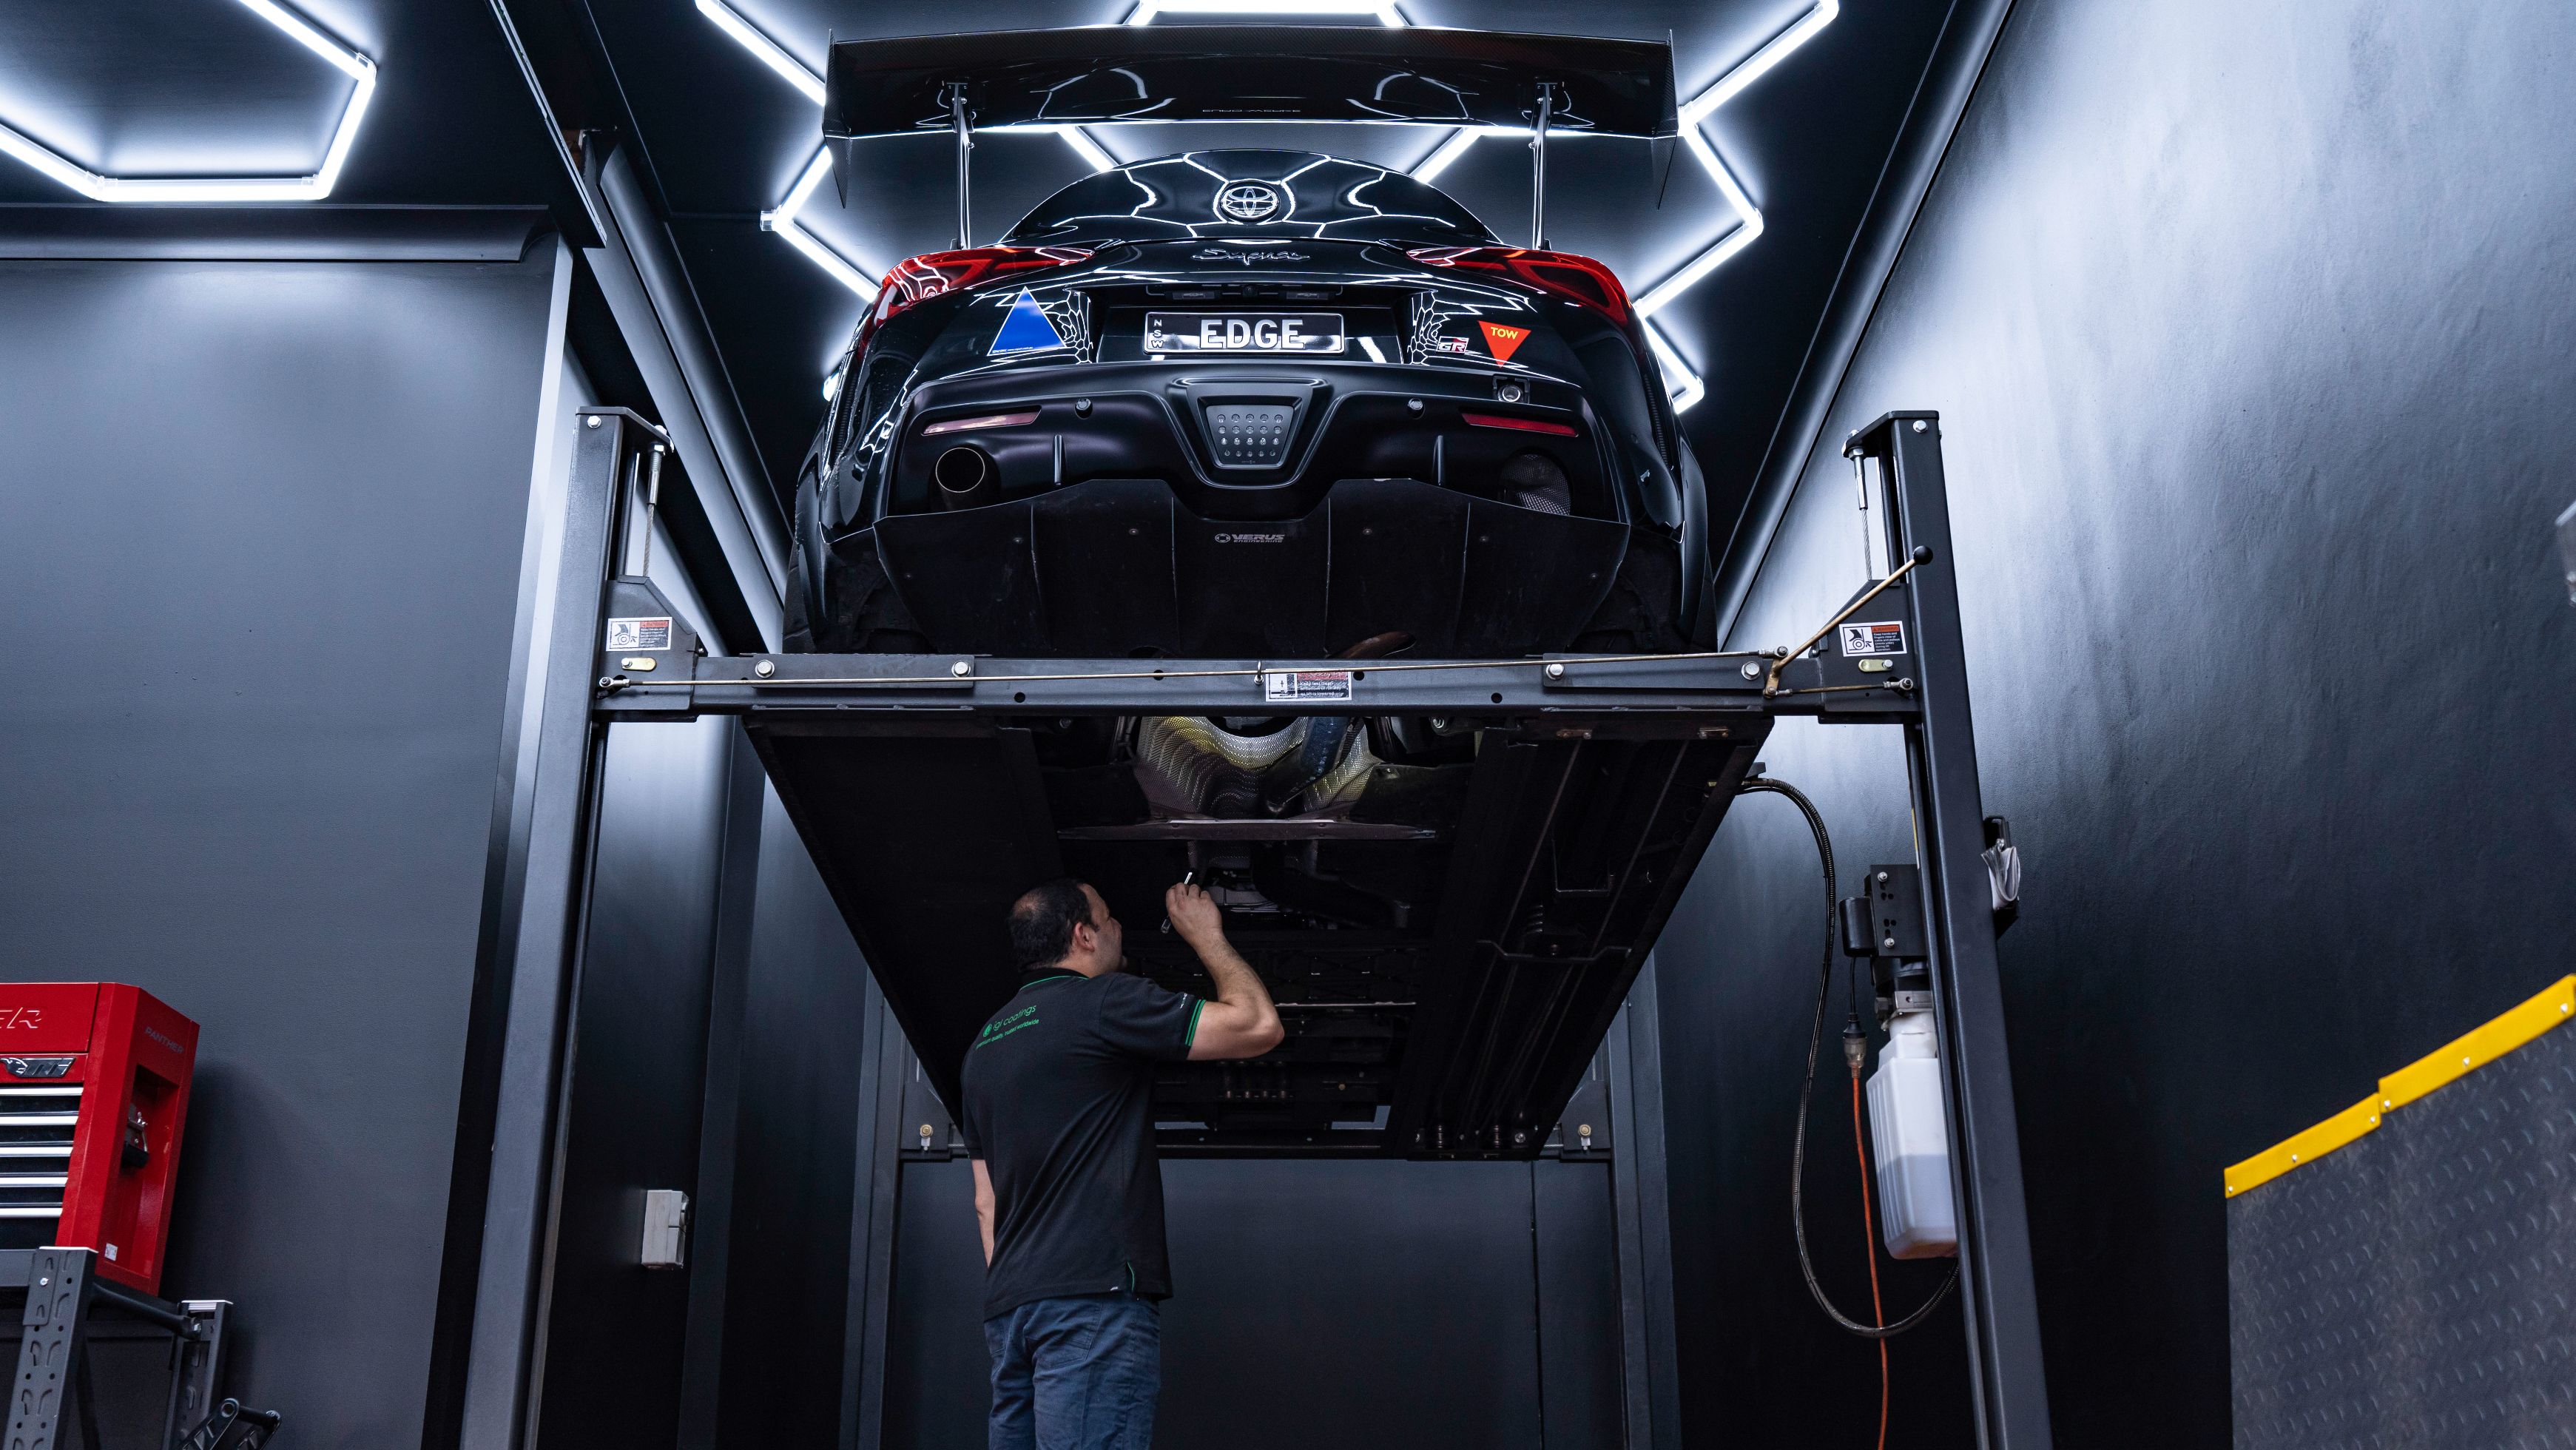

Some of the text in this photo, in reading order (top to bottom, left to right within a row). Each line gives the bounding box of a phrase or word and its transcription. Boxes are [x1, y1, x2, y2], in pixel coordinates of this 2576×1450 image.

[1199, 319, 1306, 349] EDGE
[1490, 326, 1519, 340] TOW
[145, 1026, 184, 1054] PANTHER
